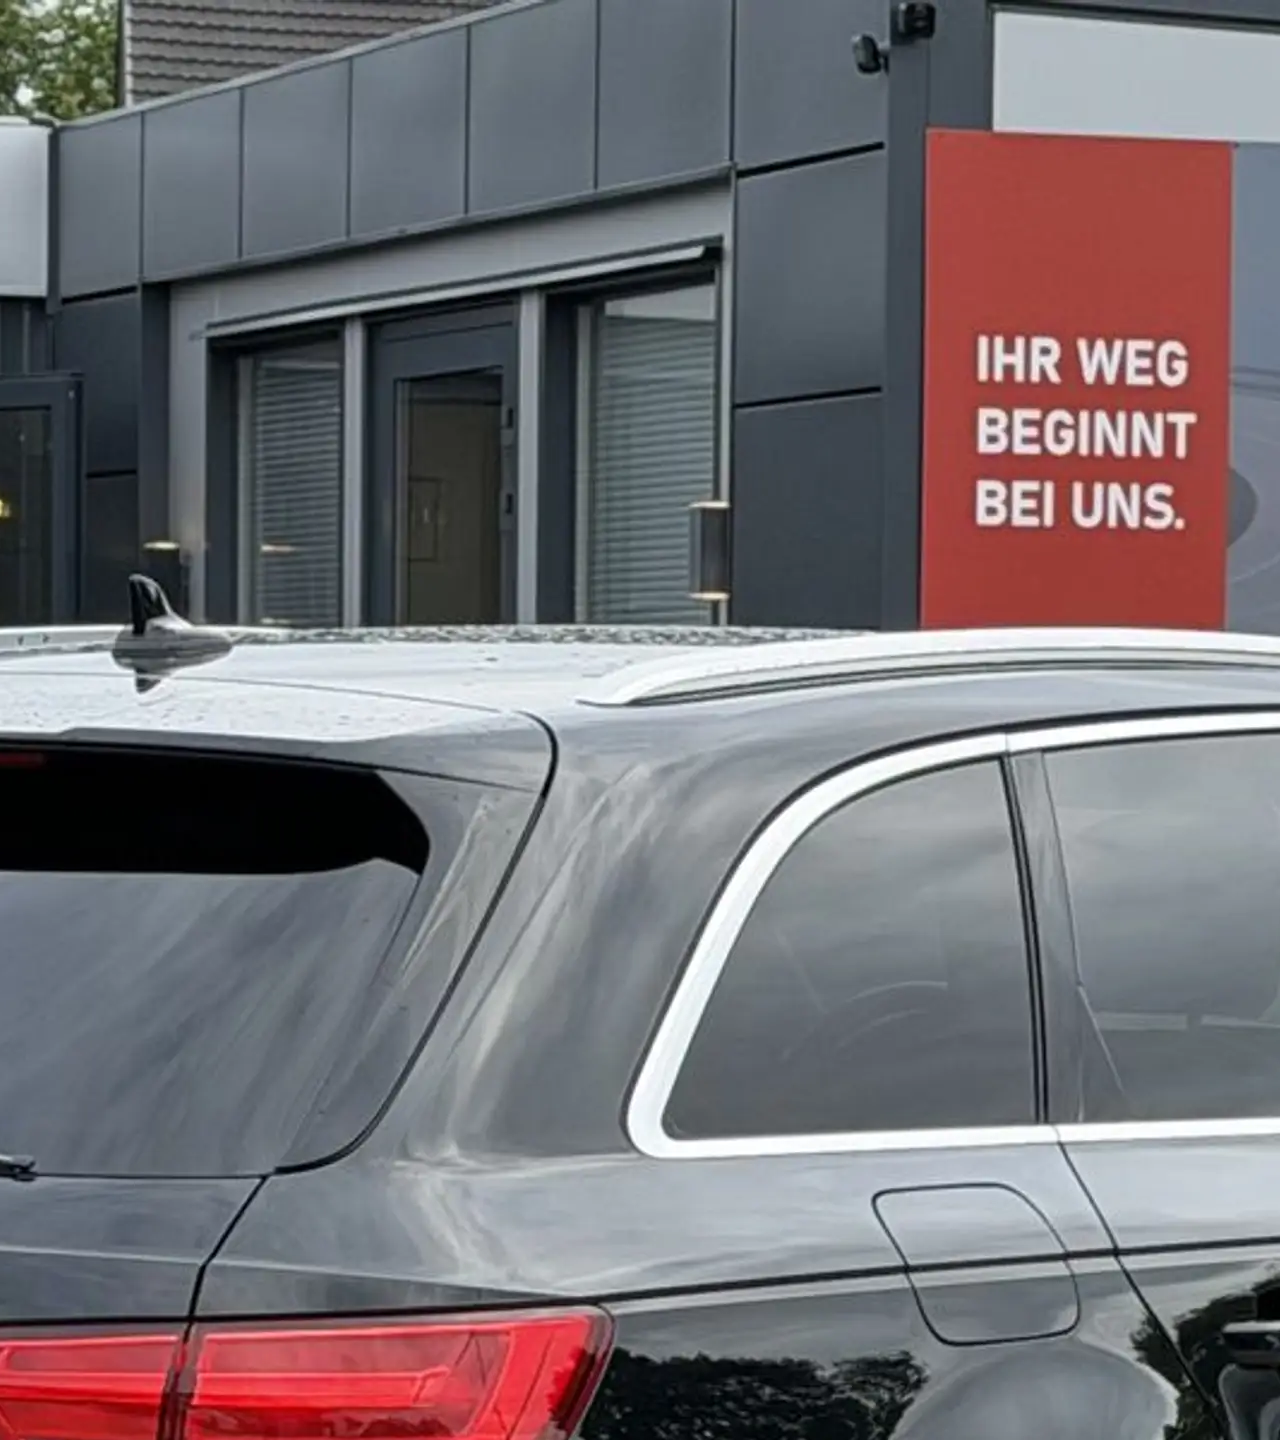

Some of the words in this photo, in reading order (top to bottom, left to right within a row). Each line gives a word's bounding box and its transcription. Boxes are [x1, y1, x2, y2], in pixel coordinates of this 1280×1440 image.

[976, 334, 1061, 384] IHR
[1076, 338, 1190, 388] WEG
[976, 407, 1198, 460] BEGINNT
[974, 479, 1055, 528] BEI
[1071, 481, 1186, 531] UNS.
